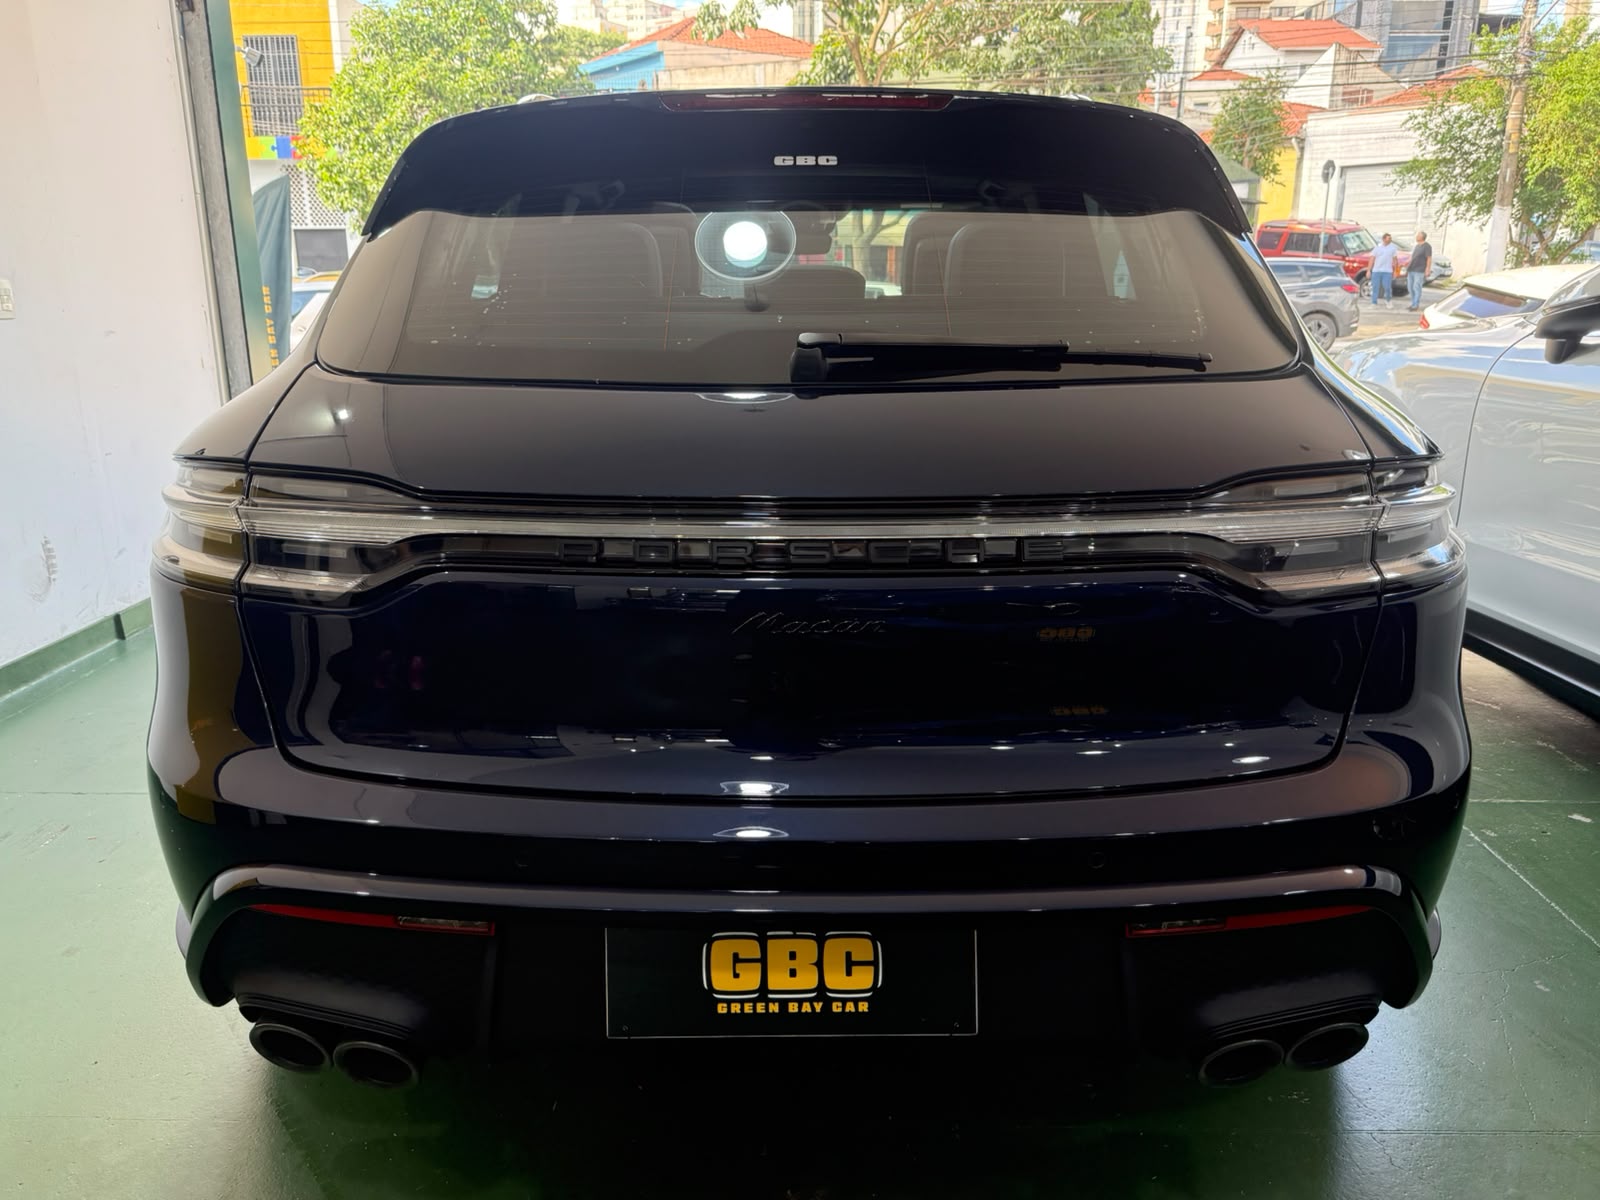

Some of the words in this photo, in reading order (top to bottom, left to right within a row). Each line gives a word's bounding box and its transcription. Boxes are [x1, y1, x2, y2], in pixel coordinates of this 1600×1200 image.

[773, 155, 838, 166] GBC
[558, 538, 1065, 565] PORSCHE
[729, 610, 888, 635] Macan
[710, 937, 876, 992] GBC
[716, 1001, 781, 1014] GREEN
[787, 1001, 824, 1014] BAY
[831, 1001, 870, 1013] CAR
